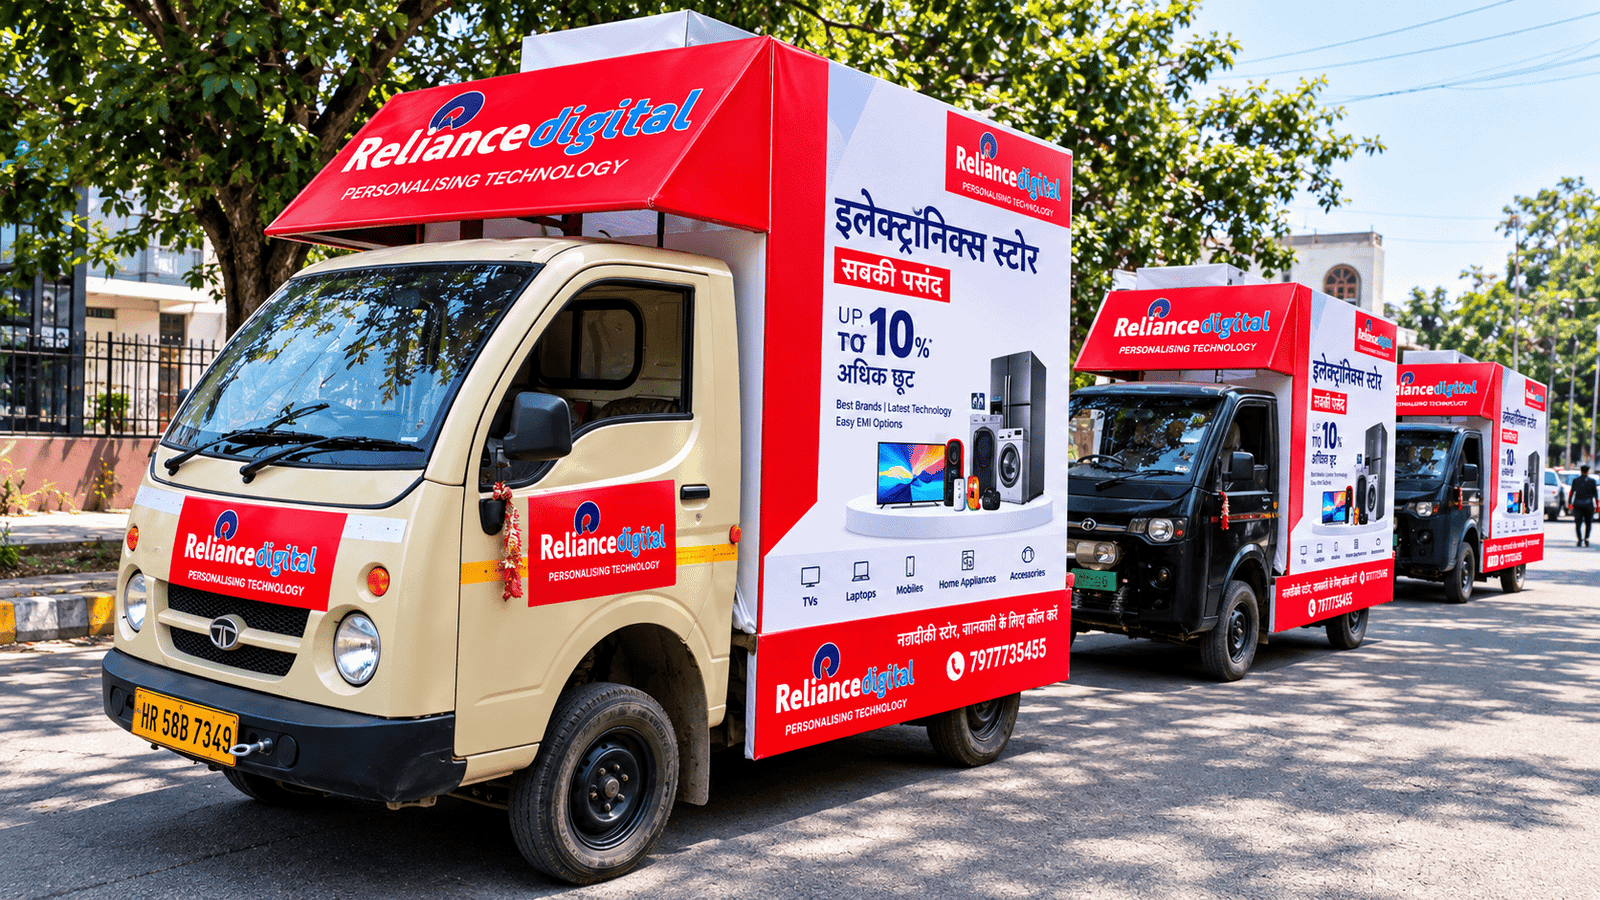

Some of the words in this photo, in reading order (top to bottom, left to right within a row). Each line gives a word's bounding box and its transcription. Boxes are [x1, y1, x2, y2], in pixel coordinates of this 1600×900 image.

[341, 172, 482, 200] PERSONALISING
[484, 159, 629, 187] TECHNOLOGY
[962, 181, 1012, 204] PERSONALISING
[834, 187, 987, 263] इलेक्ट्रॉनिक्स
[992, 229, 1040, 275] स्टोर
[841, 258, 897, 288] सबकी
[900, 267, 943, 298] पसंद
[1118, 345, 1191, 354] PERSONALISING
[1192, 342, 1258, 353] TECHNOLOGY
[837, 357, 888, 386] अधिक
[891, 368, 916, 396] छूट
[835, 416, 855, 429] Easy
[856, 417, 872, 427] EMI
[873, 418, 903, 430] Options
[836, 399, 854, 410] Best
[855, 400, 882, 412] Brands
[887, 403, 911, 413] Latest
[911, 404, 952, 418] Technology
[187, 569, 246, 588] PERSONALISING
[247, 578, 305, 596] TECHNOLOGY
[548, 565, 611, 582] PERSONALISING
[611, 560, 660, 574] TECHNOLOGY
[802, 596, 818, 607] TVs
[845, 588, 877, 603] Laptops
[895, 583, 924, 595] Mobiles
[938, 578, 959, 590] Home
[960, 574, 997, 589] Appliances
[1009, 568, 1046, 581] Accessories
[969, 637, 1047, 674] 7977735455
[140, 702, 158, 732] HR
[162, 709, 189, 741] 58B
[193, 718, 232, 754] 7349
[785, 710, 854, 736] PERSONALISING
[854, 698, 908, 719] TECHNOLOGY
